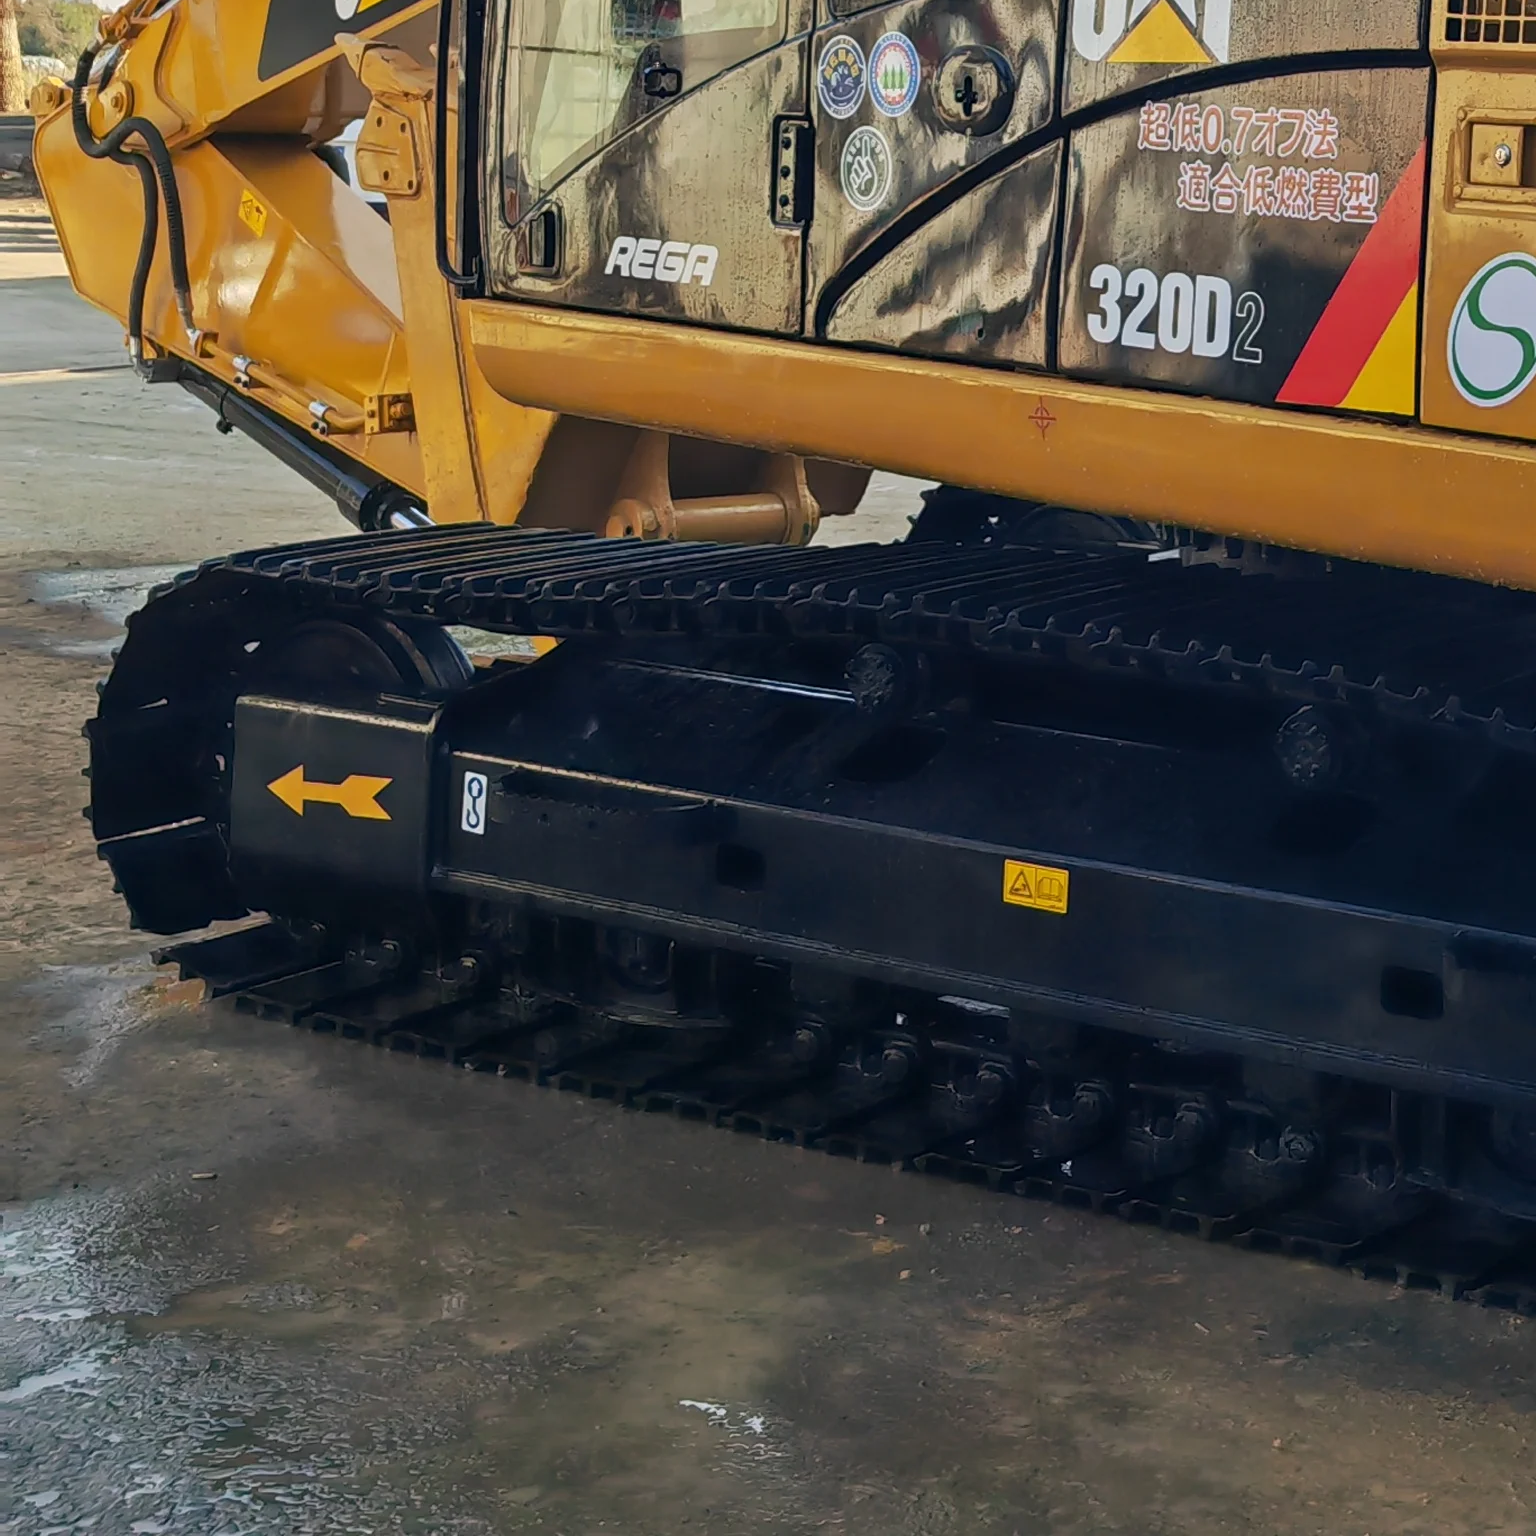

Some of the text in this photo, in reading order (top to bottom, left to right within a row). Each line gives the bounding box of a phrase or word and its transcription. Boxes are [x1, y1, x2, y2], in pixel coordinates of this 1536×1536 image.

[1177, 160, 1379, 223] 適合低燃費型
[604, 235, 719, 287] REGA
